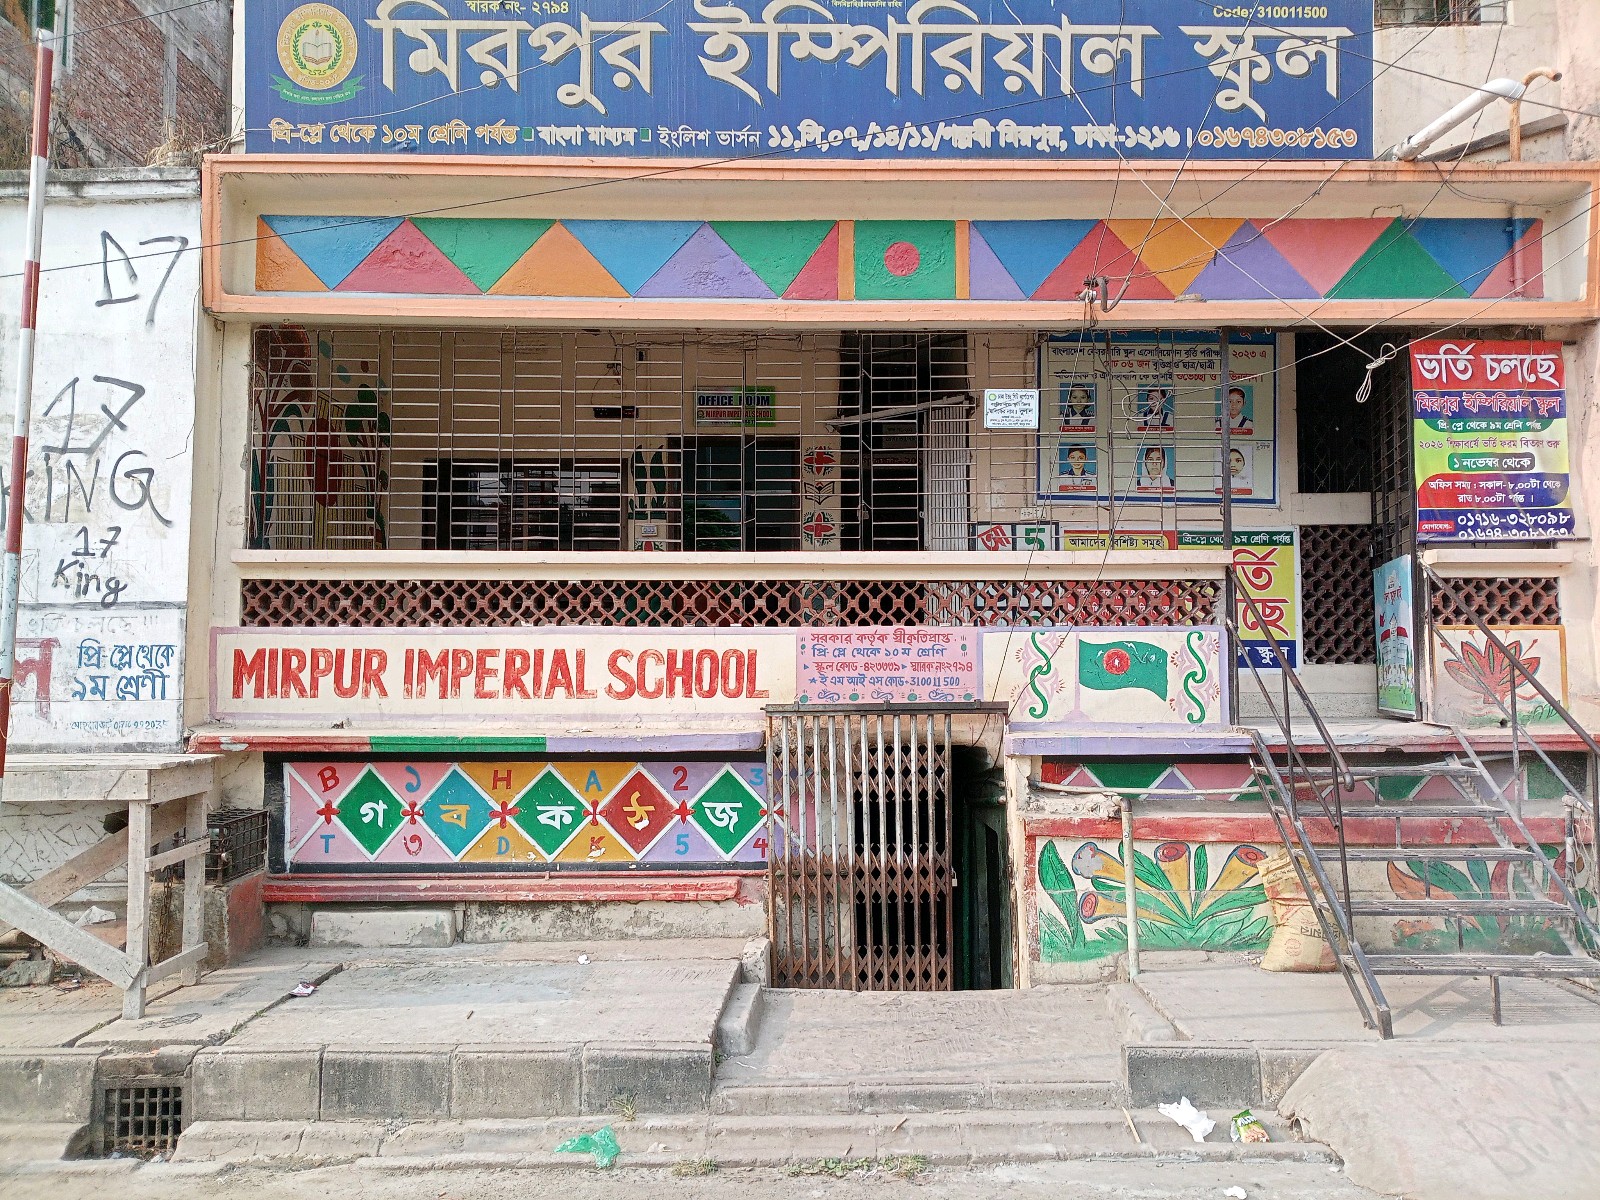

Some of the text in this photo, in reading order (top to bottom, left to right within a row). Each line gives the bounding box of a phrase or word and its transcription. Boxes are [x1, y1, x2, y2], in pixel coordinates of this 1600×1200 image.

[532, 1, 569, 15] ২৭৯৪
[1213, 6, 1328, 19] Code: 310011500
[364, 0, 668, 115] মিরপুর
[686, 0, 1162, 108] ইম্পিরিয়াল
[1178, 26, 1357, 124] স্কুল
[330, 122, 377, 143] থেকে
[381, 124, 423, 145] ১০ম
[475, 119, 520, 144] পর্যন্ত
[536, 124, 584, 147] বাংলা
[585, 125, 638, 147] মাধ্যম
[657, 124, 711, 150] ইংলিশ
[715, 125, 762, 149] ভার্সন
[1232, 350, 1257, 359] ২০২৩
[1414, 343, 1560, 387] ভর্তি চলছে
[698, 395, 734, 406] OFFICE
[1415, 392, 1460, 416] মিরপুর
[1534, 396, 1562, 417] স্কুল
[727, 410, 751, 418] IMPEAL
[1466, 421, 1487, 430] থেকে
[1419, 440, 1444, 449] ২০২৬
[1482, 437, 1498, 448] ভর্তি
[1462, 457, 1499, 469] নভেম্বর
[1502, 457, 1532, 469] থেকে
[1428, 479, 1453, 489] অফিস
[1457, 494, 1473, 503] রাত
[1457, 511, 1571, 528] ০১৭১৬-৩২৮০৯৮
[72, 525, 122, 558] 17
[1069, 537, 1106, 550] আমাদের
[1234, 533, 1248, 543] ৯ম
[1272, 532, 1293, 544] পর্যন্ত
[51, 558, 128, 608] King
[811, 633, 853, 645] সরকার
[855, 629, 889, 647] কর্তৃক
[109, 644, 134, 671] প্লে
[135, 643, 177, 670] থেকে
[832, 647, 847, 658] প্লে
[851, 647, 881, 658] থেকে
[917, 643, 948, 658] শ্রেণি
[232, 648, 770, 700] MIRPUR IMPERIAL SCHOOL
[835, 661, 859, 673] কোড
[116, 668, 171, 700] শ্রেণী
[818, 672, 829, 687] ই
[830, 676, 845, 686] এম
[846, 673, 868, 687] আই
[868, 676, 885, 687] এস
[317, 766, 340, 793] B
[492, 771, 512, 790] H
[585, 769, 602, 792] A
[673, 765, 689, 791] 2
[749, 768, 765, 786] 3
[360, 801, 387, 828] গ
[440, 804, 469, 830] ব
[536, 805, 575, 833] ক
[702, 801, 743, 834] জ
[319, 834, 336, 854] T
[497, 836, 510, 855] D
[675, 833, 690, 855] 5
[753, 837, 768, 858] 4
